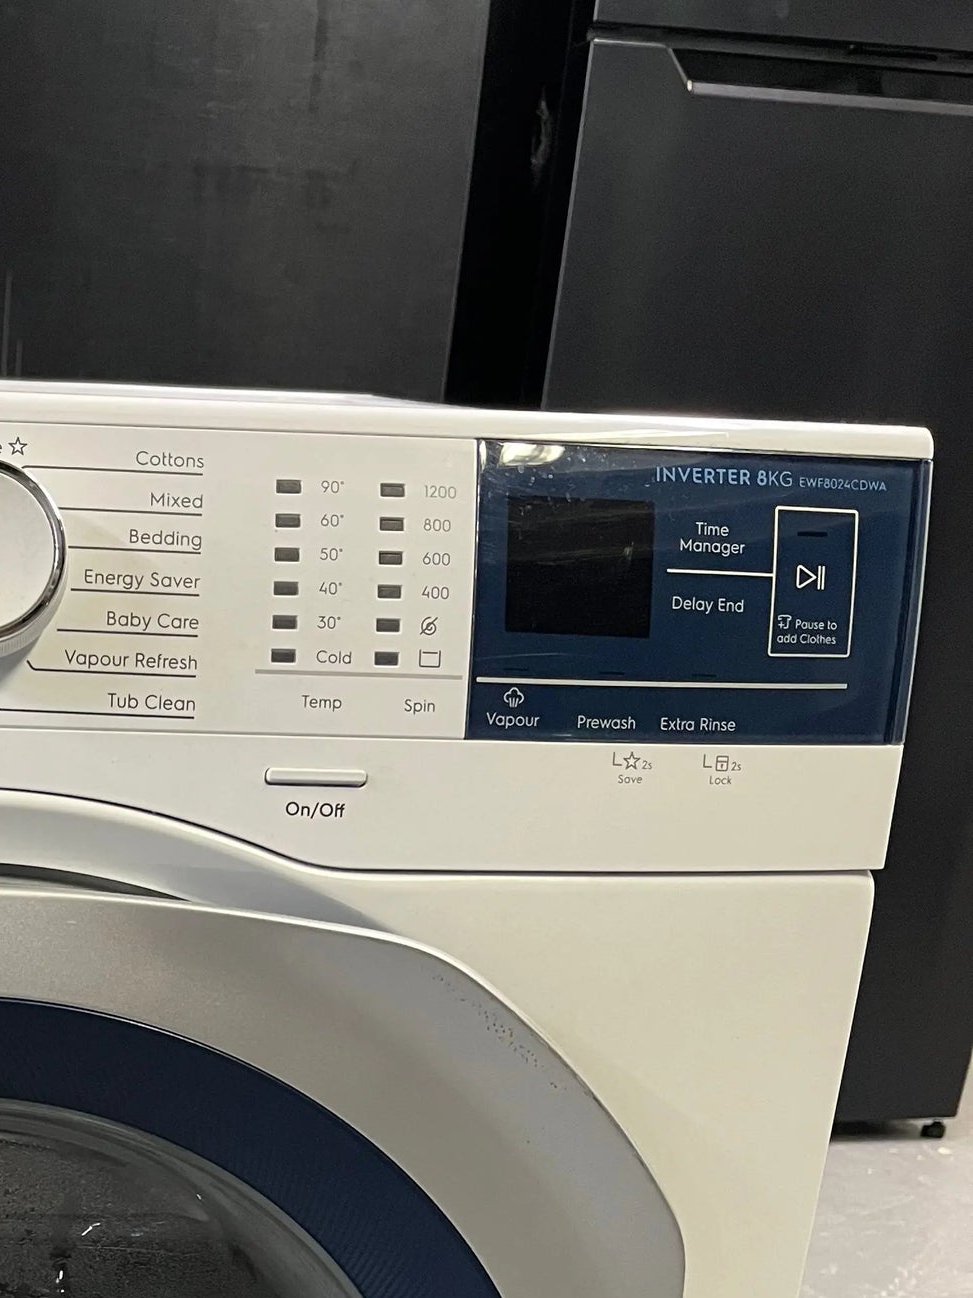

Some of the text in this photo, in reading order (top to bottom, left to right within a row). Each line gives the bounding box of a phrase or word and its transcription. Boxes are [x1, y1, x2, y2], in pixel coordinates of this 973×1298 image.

[136, 451, 204, 469] Cottons
[656, 466, 887, 492] INVERTER 8KG EWF8024CDWA
[151, 491, 203, 509] Mixed
[424, 484, 457, 500] 1200
[423, 518, 451, 532] 800
[695, 521, 730, 537] Time
[129, 528, 202, 551] Bedding
[680, 538, 746, 558] Manager
[422, 552, 451, 566] 600
[84, 569, 201, 590] Energy Saver
[421, 586, 450, 600] 400
[671, 596, 745, 614] Delay End
[106, 611, 200, 631] Baby Care
[795, 619, 838, 631] Pause to
[777, 634, 837, 645] add Clothes
[64, 649, 198, 670] Vapour Refresh
[316, 650, 352, 665] Cold
[107, 692, 196, 712] Tub Clean
[301, 694, 343, 711] Temp
[404, 698, 436, 715] Spin
[486, 711, 540, 729] Vapour
[577, 715, 636, 730] Prewash
[660, 717, 736, 732] Extra Rinse
[617, 774, 643, 785] Save
[709, 775, 732, 786] Lock
[285, 801, 346, 819] On/Off
